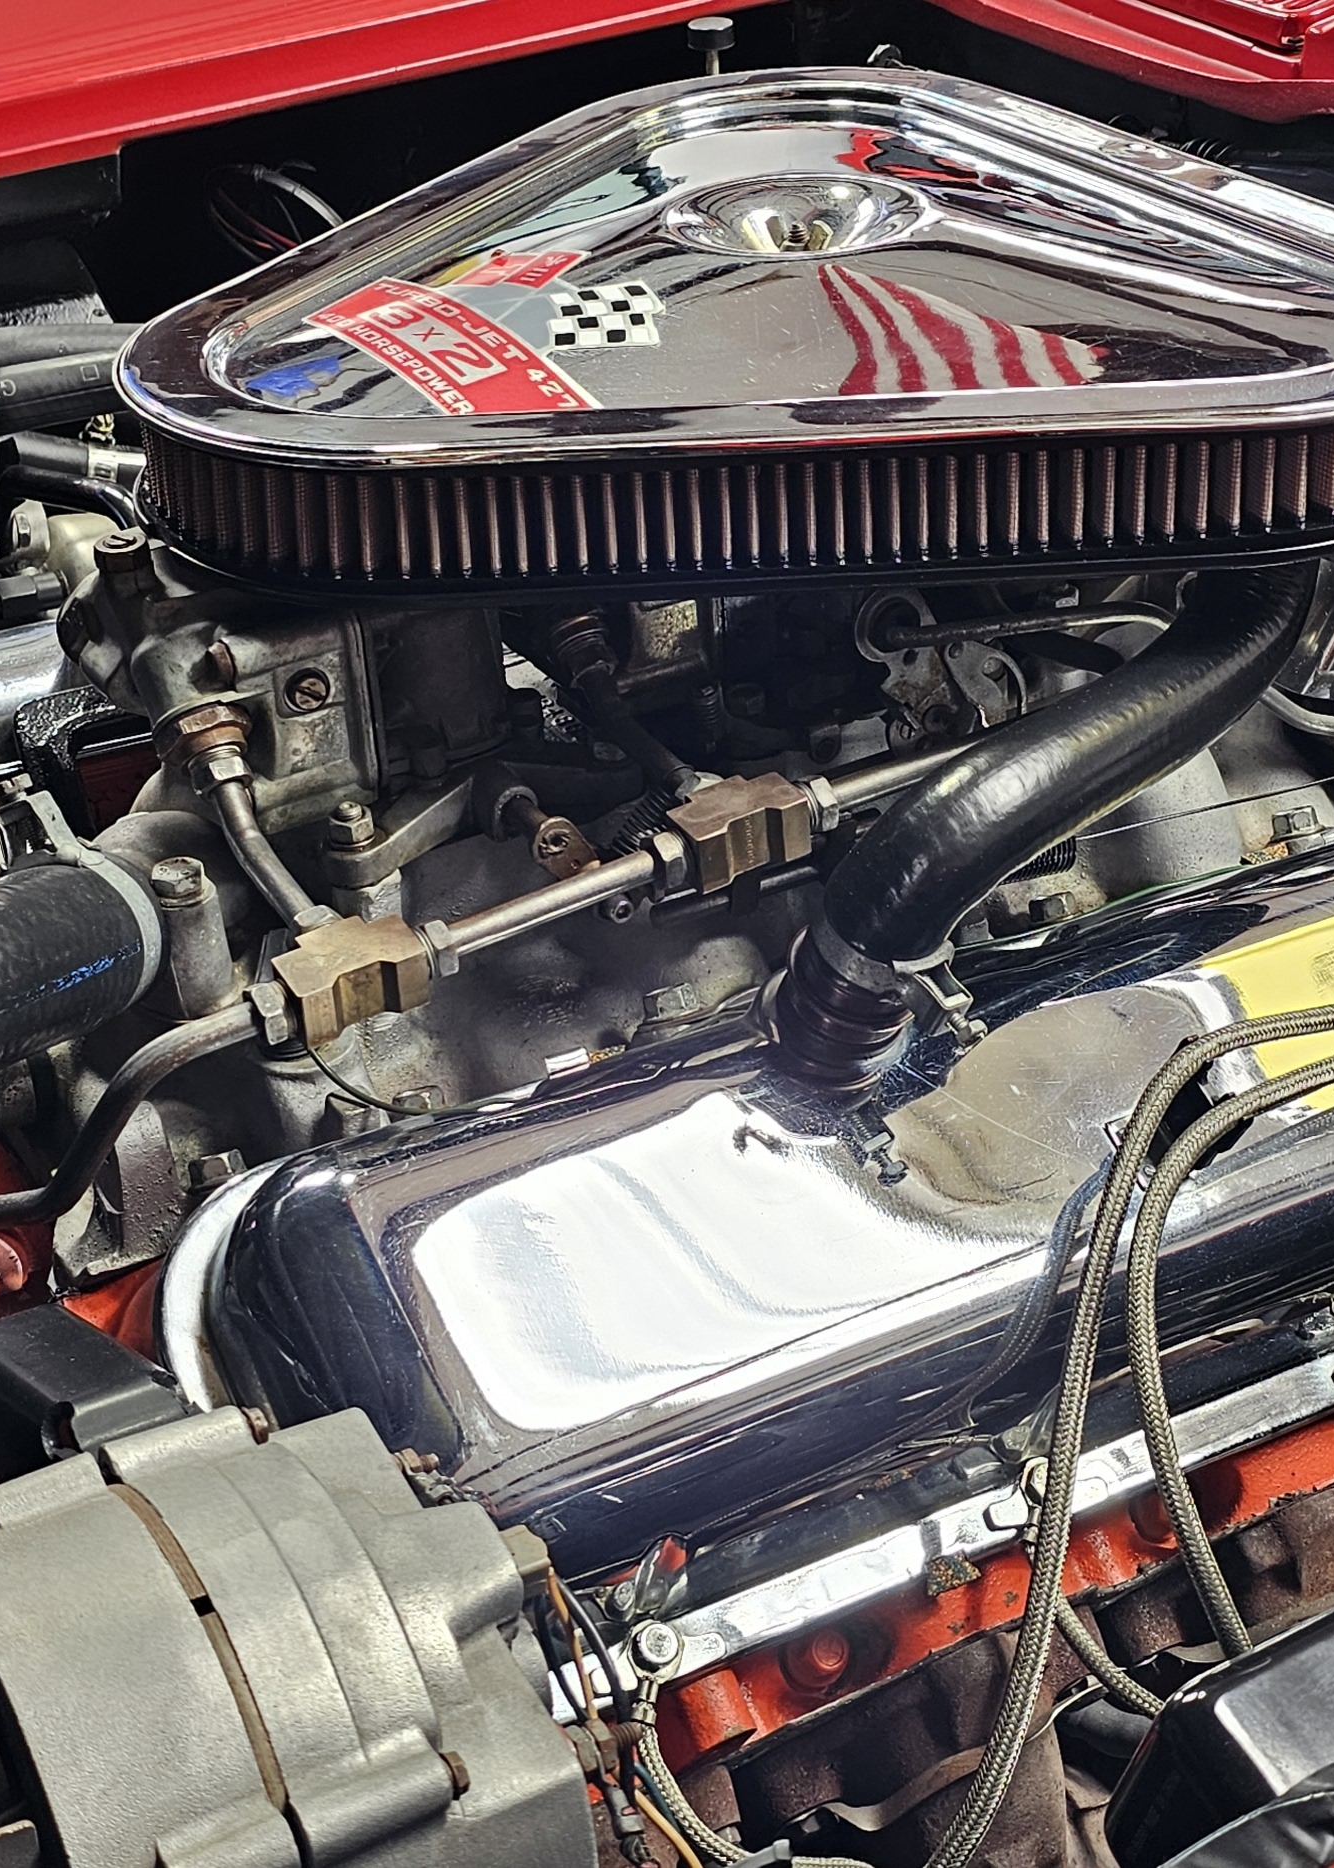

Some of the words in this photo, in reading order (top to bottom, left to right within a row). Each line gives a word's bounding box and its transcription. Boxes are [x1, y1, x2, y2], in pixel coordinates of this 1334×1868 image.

[317, 312, 354, 327] 400
[347, 323, 476, 415] HORSEPOWER
[373, 282, 529, 362] TURBO-JET
[526, 368, 580, 408] 427
